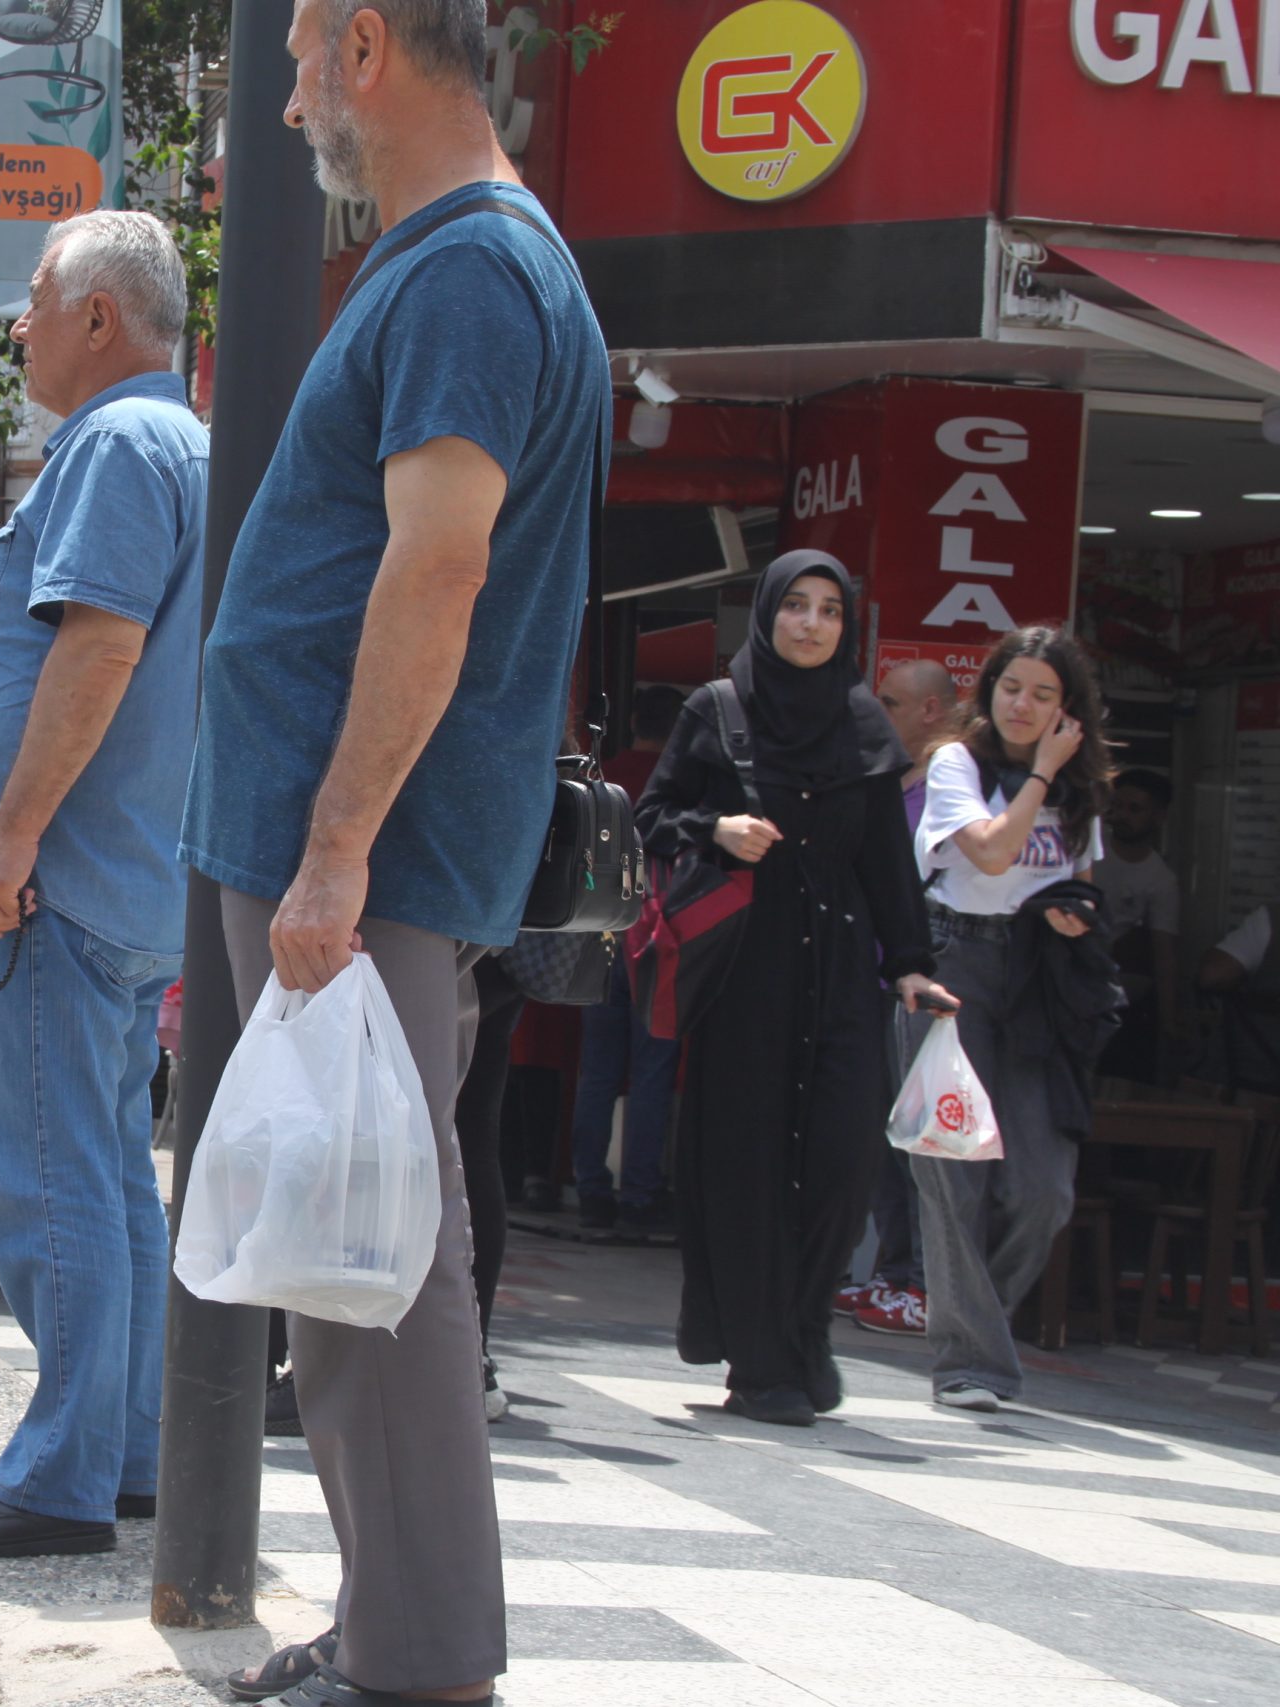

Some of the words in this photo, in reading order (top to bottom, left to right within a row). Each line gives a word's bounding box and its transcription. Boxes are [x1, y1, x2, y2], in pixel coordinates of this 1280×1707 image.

[744, 151, 798, 188] arf
[793, 453, 863, 520] GALA
[921, 416, 1030, 633] GALA
[945, 654, 983, 669] GAL
